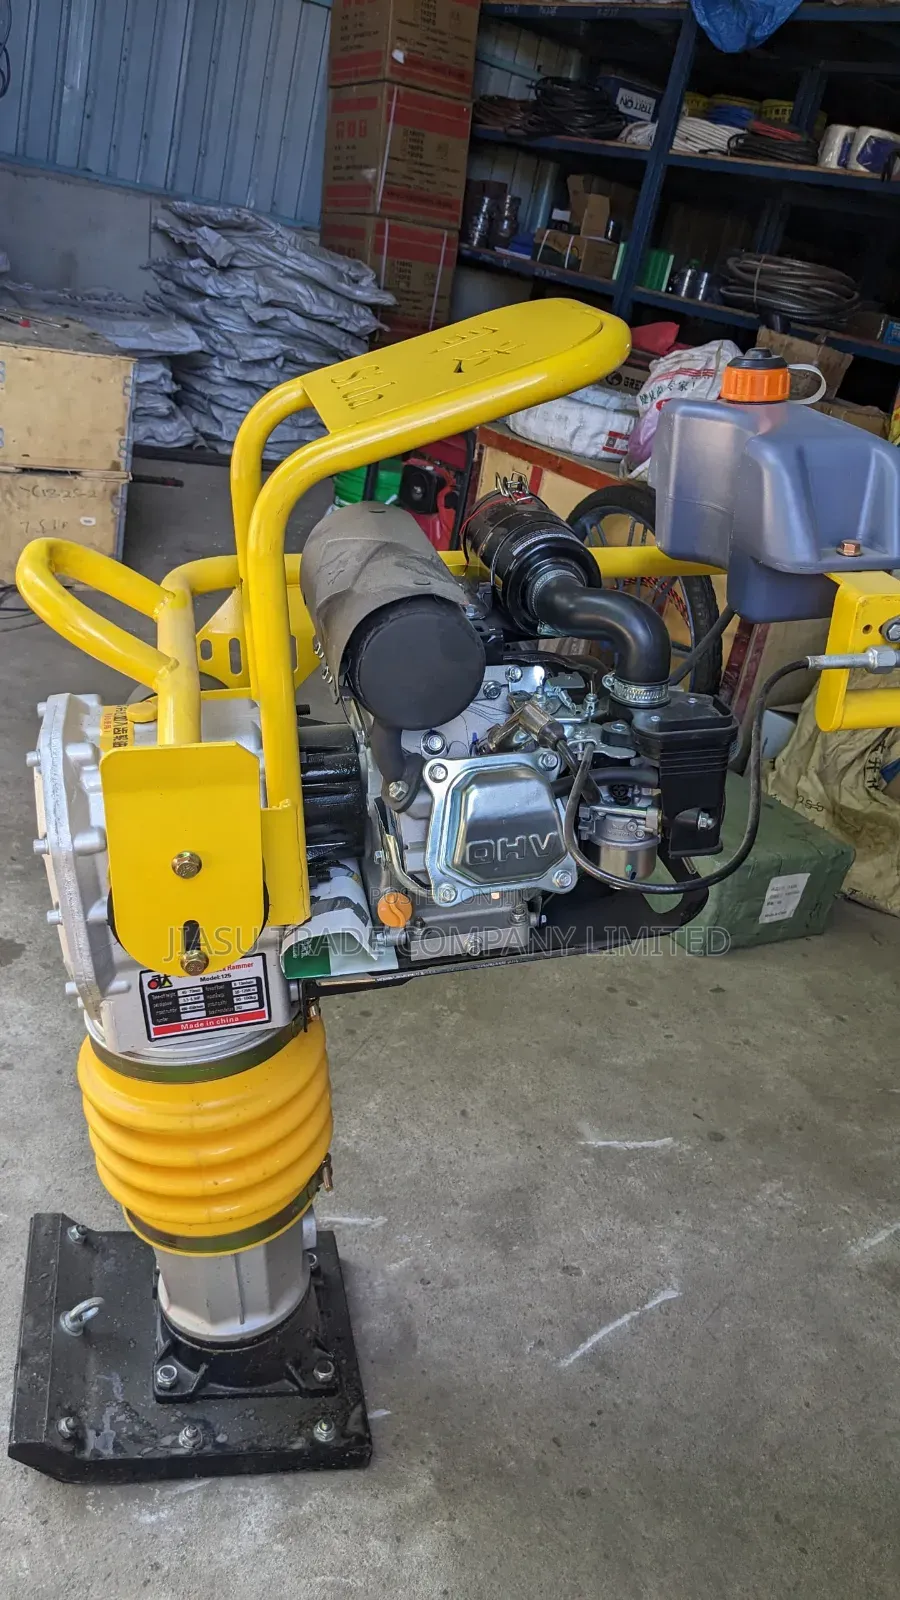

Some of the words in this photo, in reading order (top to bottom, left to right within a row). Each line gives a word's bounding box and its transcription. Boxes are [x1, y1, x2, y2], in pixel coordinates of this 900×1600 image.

[180, 1020, 204, 1030] Made
[206, 1018, 215, 1026] in
[216, 1015, 239, 1025] china
